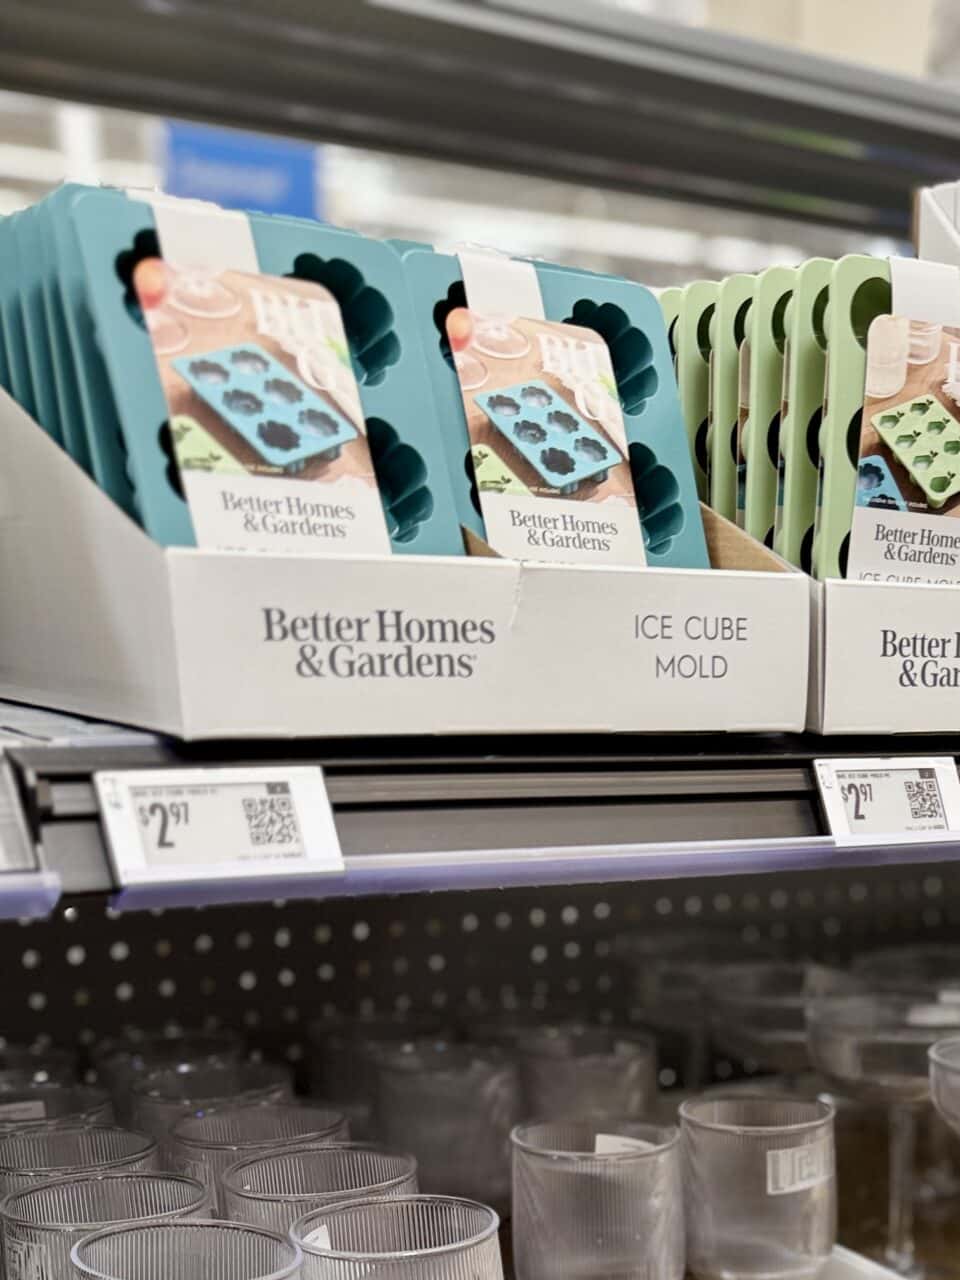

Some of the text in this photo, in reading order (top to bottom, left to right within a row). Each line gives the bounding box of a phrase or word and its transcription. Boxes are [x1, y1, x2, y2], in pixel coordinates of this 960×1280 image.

[220, 490, 356, 520] Better Homes
[509, 509, 619, 536] Better Homes
[874, 523, 919, 545] Better
[262, 606, 496, 644] Better Homes
[634, 614, 748, 642] ICE CUBE
[880, 629, 954, 659] Better
[655, 654, 729, 679] MOLD
